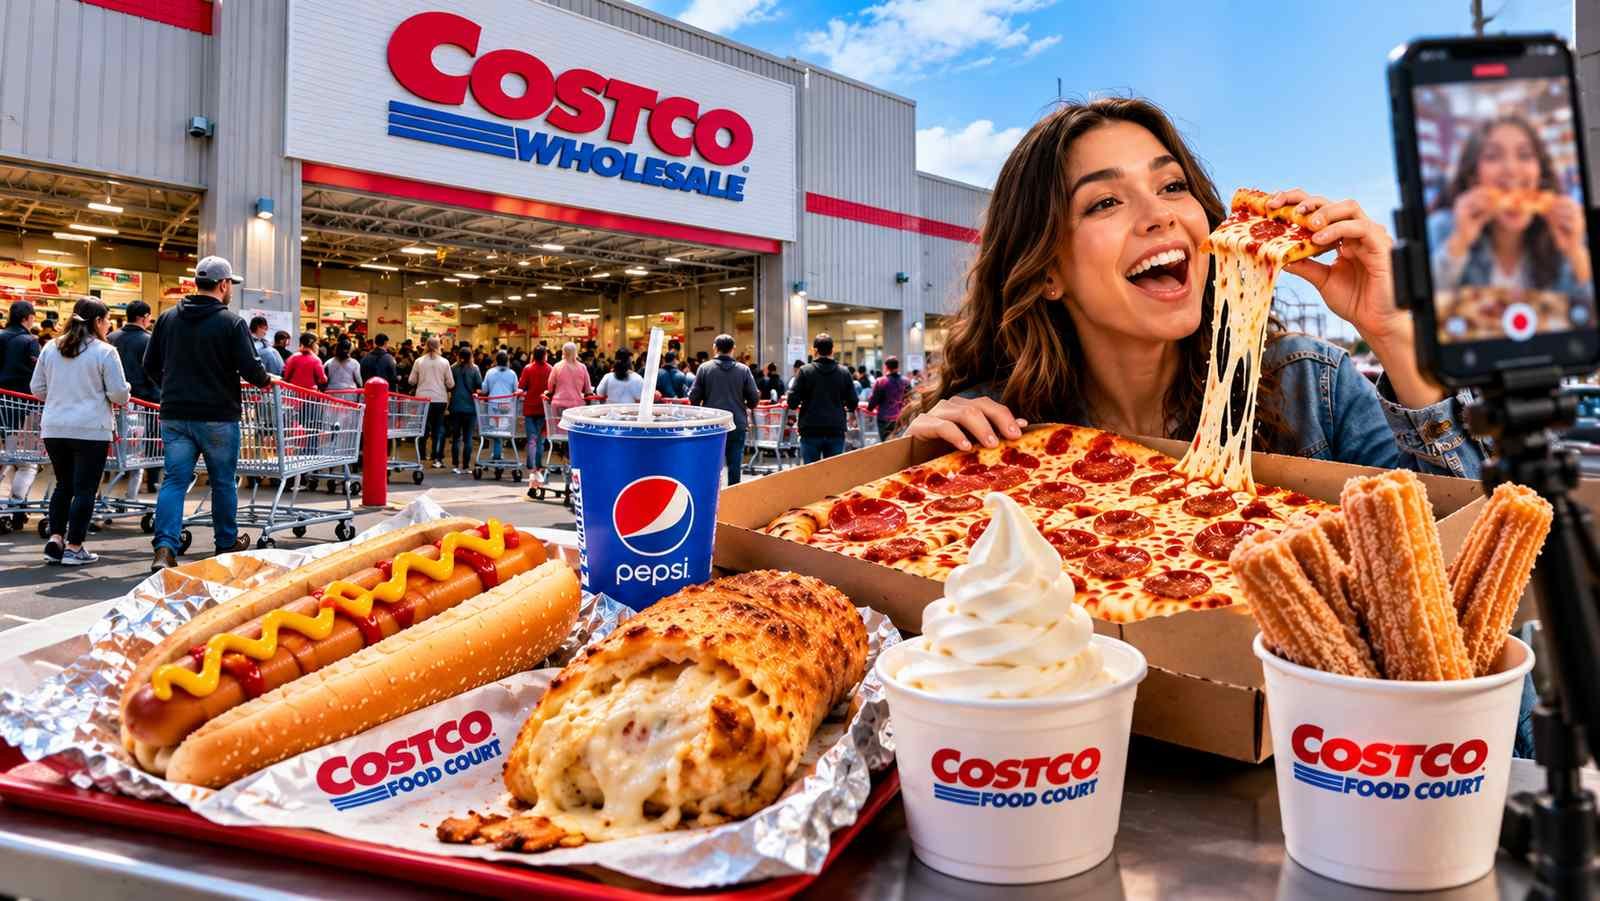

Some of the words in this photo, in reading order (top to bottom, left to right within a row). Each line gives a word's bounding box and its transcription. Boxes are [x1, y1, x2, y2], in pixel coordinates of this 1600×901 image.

[387, 11, 754, 166] COSTCO
[515, 128, 746, 202] WHOLESALE
[616, 557, 689, 586] pepsi
[316, 710, 493, 796] COSTCO
[385, 765, 442, 797] FOOD
[444, 739, 502, 776] COURT
[931, 747, 1101, 789] COSTCO
[1291, 723, 1488, 778] COSTCO
[981, 791, 1037, 808] FOOD
[1041, 778, 1098, 805] COURT
[1343, 777, 1410, 800] FOOD
[1414, 775, 1485, 800] COURT
